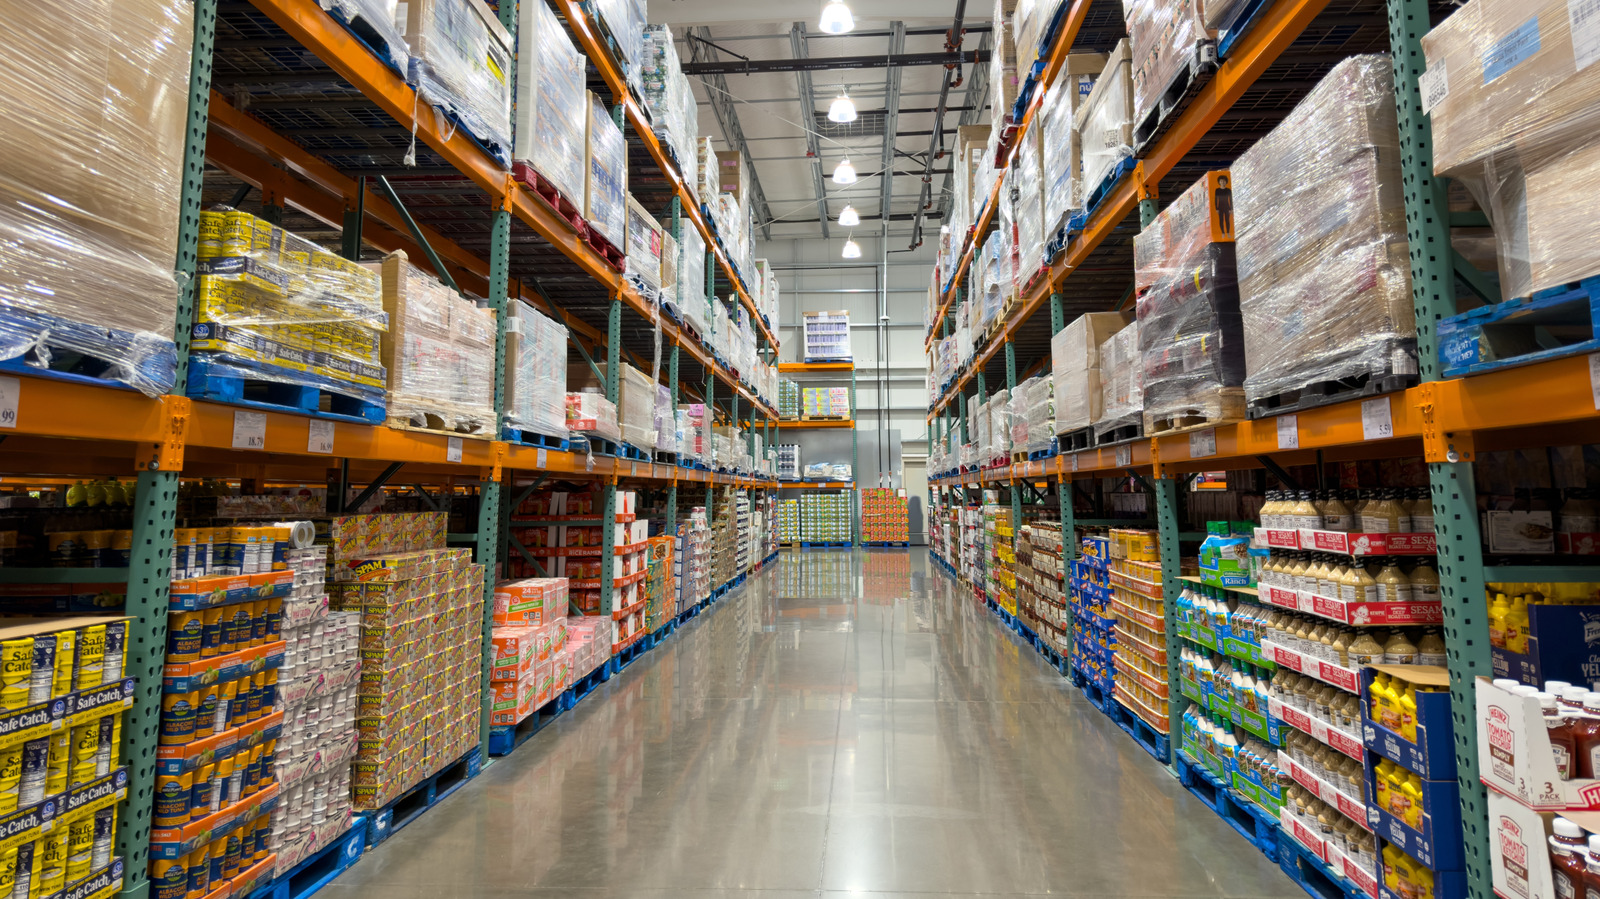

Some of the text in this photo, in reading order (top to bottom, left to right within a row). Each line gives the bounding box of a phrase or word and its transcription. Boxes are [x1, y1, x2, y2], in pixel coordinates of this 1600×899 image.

[202, 219, 221, 228] Safe
[355, 560, 383, 577] SPAM
[77, 689, 122, 710] Safe Catch
[19, 710, 50, 728] Catch
[1490, 708, 1507, 724] HEINZ
[1488, 722, 1512, 743] TOMATO
[1490, 735, 1511, 751] KETCHUP
[1519, 777, 1526, 790] 3
[1544, 782, 1554, 794] 3
[68, 782, 114, 809] Safe Catch
[8, 814, 40, 834] Catch
[1501, 819, 1519, 837] HEINZ
[1500, 832, 1525, 857] TOMATO
[1503, 845, 1525, 865] KETCHUP
[84, 874, 111, 894] Catch
